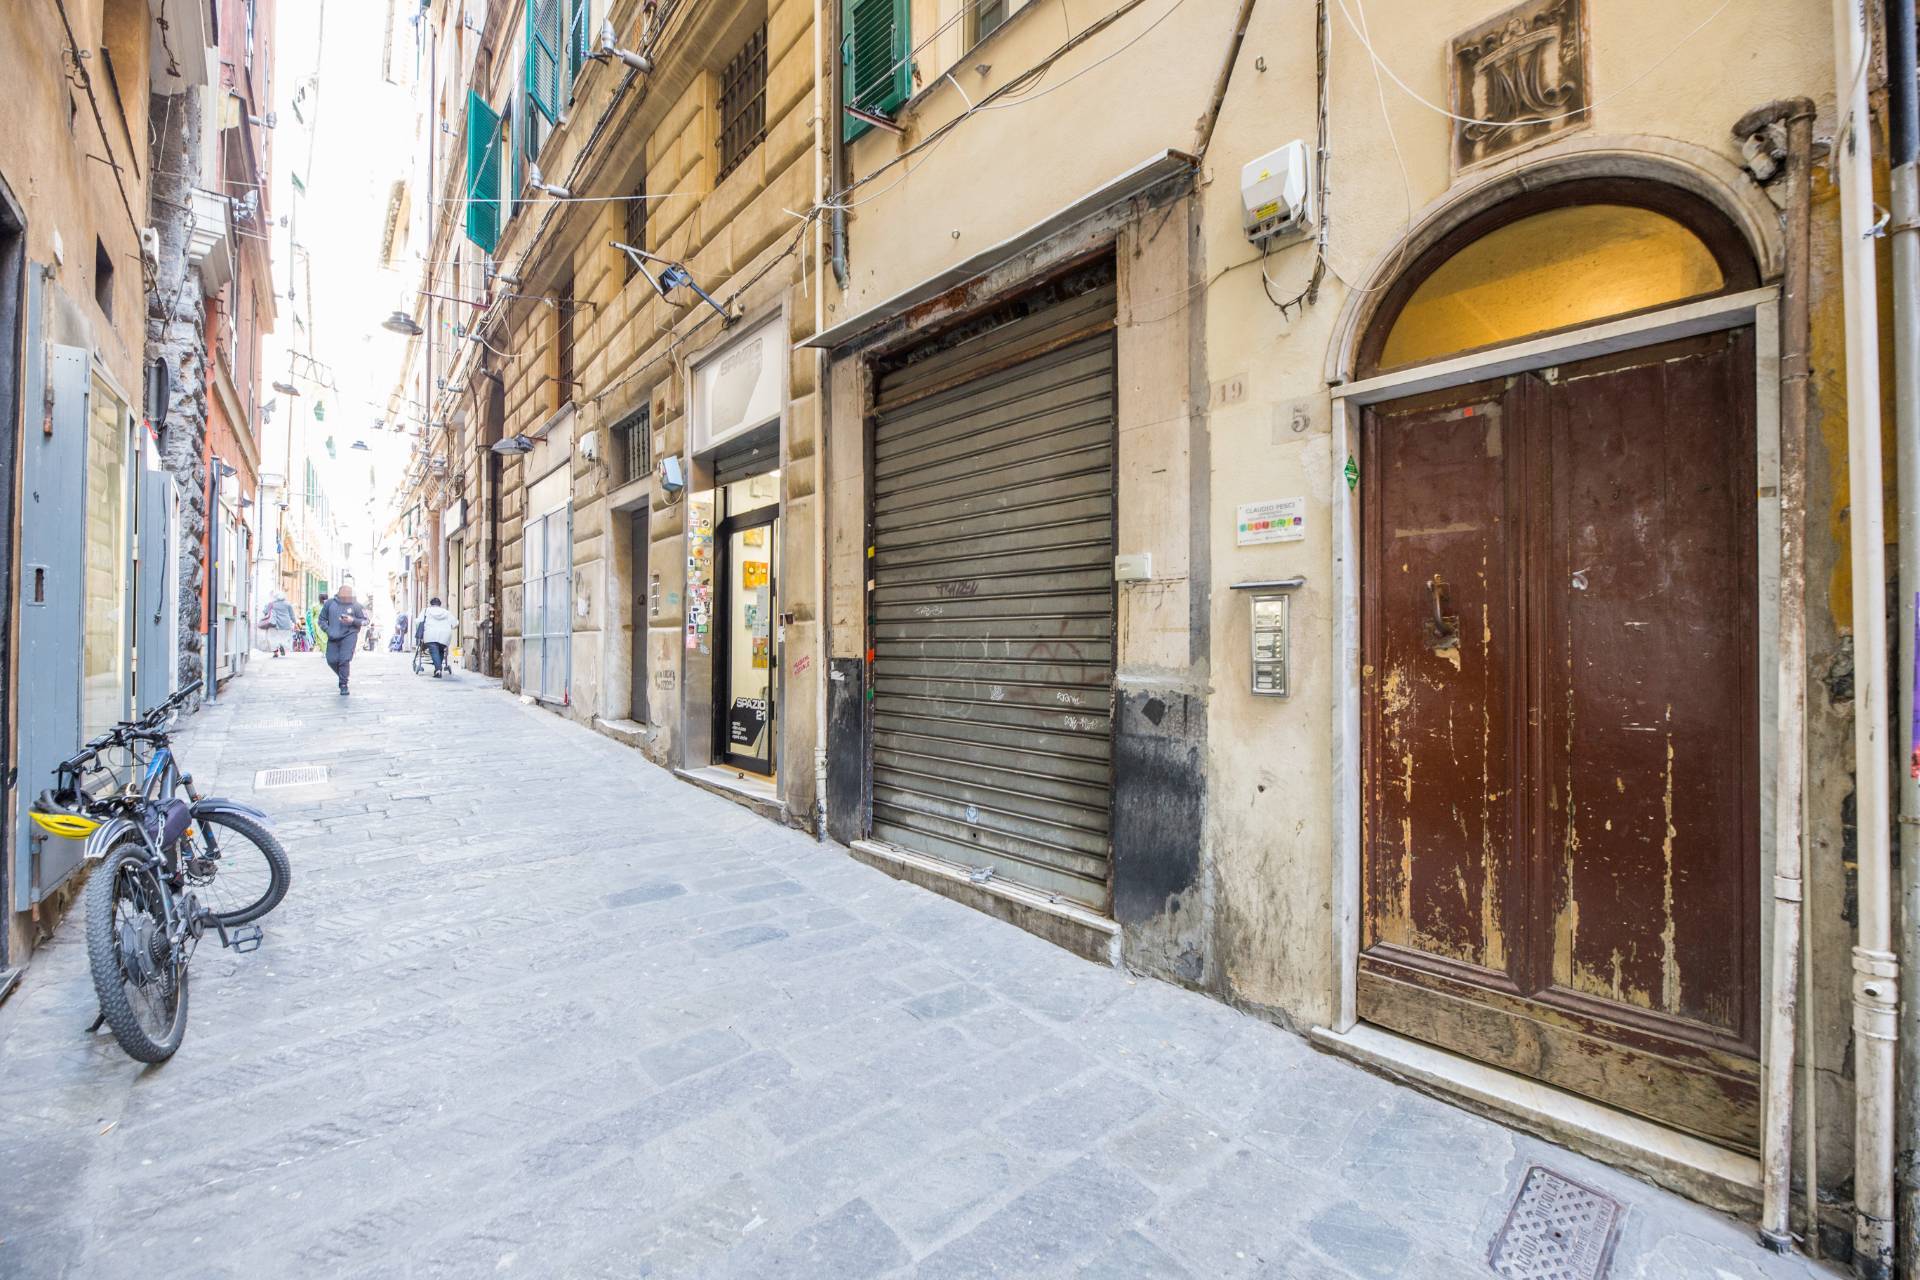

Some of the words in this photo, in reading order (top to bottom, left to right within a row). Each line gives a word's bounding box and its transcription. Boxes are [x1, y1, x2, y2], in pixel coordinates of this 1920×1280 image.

[1291, 405, 1311, 432] 5
[736, 697, 766, 710] SPAZIO
[755, 710, 766, 721] 21
[1534, 1176, 1562, 1221] NICOLAY
[1514, 1234, 1541, 1275] ACQUA
